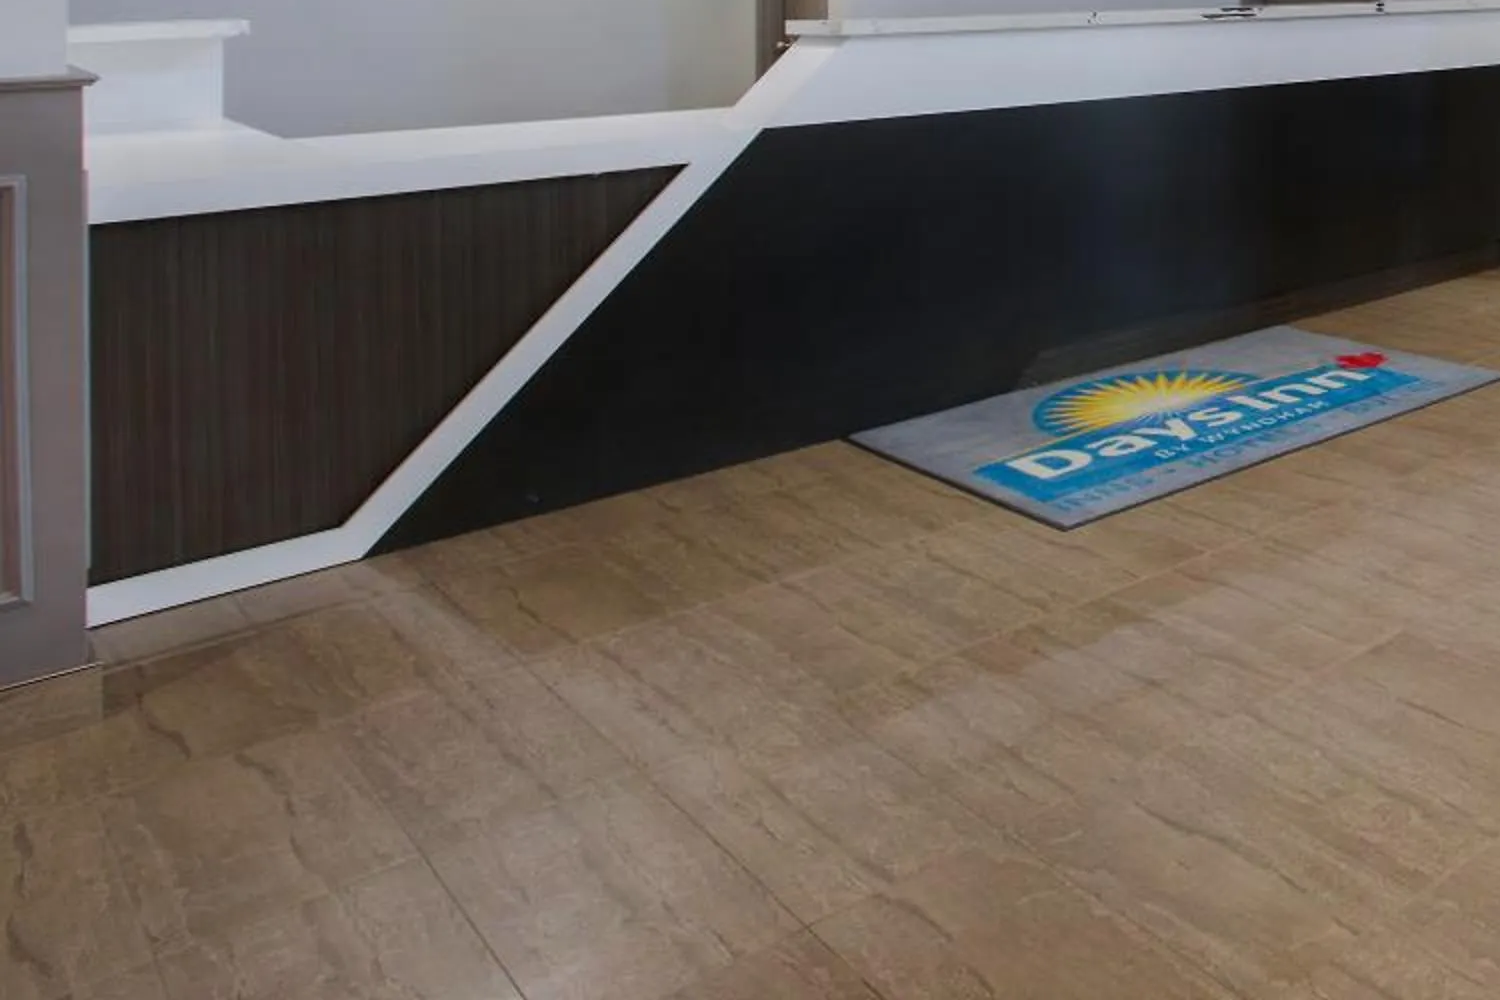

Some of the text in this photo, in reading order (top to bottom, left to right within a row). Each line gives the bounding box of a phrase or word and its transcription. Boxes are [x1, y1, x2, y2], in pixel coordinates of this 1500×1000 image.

[1005, 406, 1244, 480] Days
[1226, 368, 1371, 411] Inn
[1154, 400, 1330, 460] BY WYNDHAM
